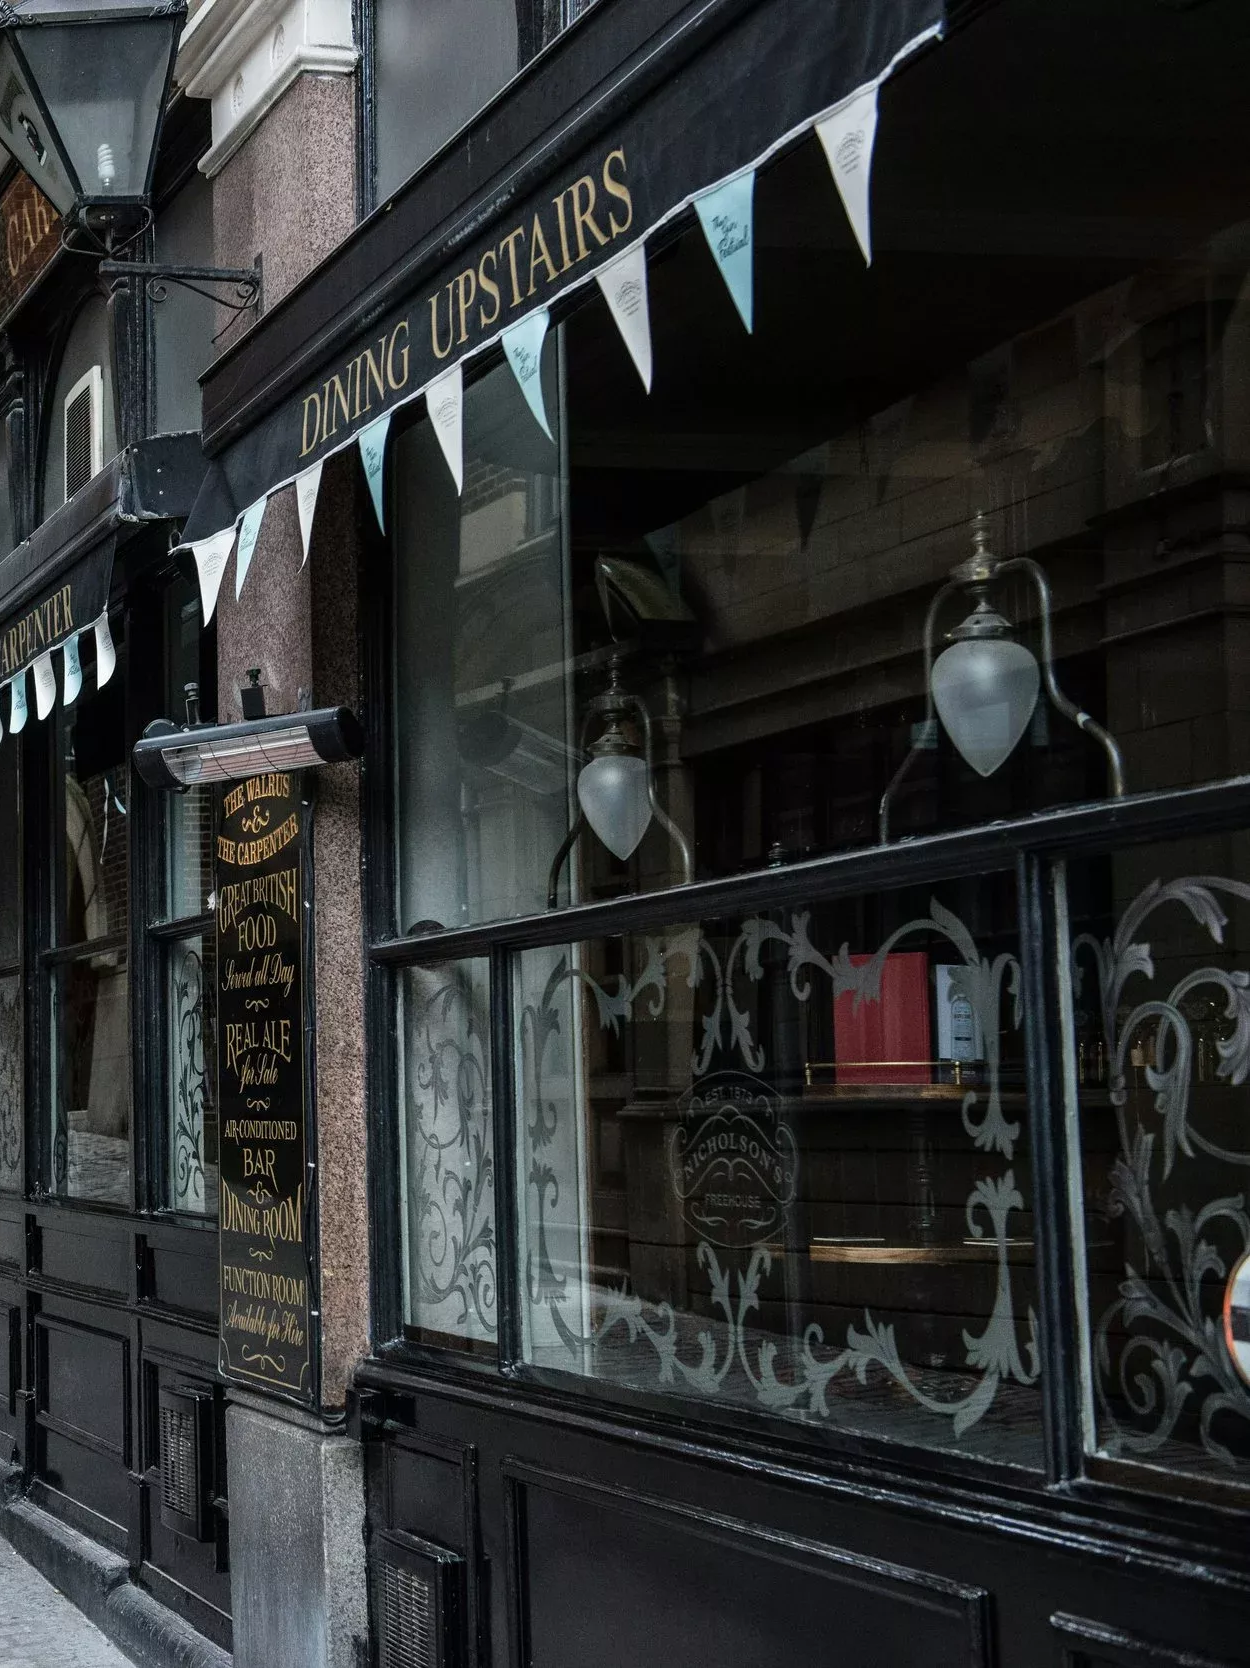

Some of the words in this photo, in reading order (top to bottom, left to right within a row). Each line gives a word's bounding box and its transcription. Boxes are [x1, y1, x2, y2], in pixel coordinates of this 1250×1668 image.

[299, 321, 410, 458] DINING
[428, 146, 633, 359] UPSTAIRS
[223, 784, 246, 818] THE
[246, 773, 290, 802] WALRUS
[217, 835, 236, 864] THE
[237, 812, 299, 866] CARPENTER
[241, 805, 270, 833] &
[218, 879, 252, 934] GREAT
[252, 868, 299, 923] BRITISH
[238, 912, 276, 952] FOOD
[222, 957, 253, 992] Served
[254, 953, 269, 985] all
[268, 951, 295, 997] Day
[226, 1022, 259, 1070] REAL
[263, 1019, 292, 1064] ALE
[239, 1056, 255, 1094] for
[254, 1053, 278, 1086] Sale
[224, 1119, 297, 1146] AIR-CONDITIONED
[243, 1148, 278, 1192] BAR
[683, 1132, 783, 1185] NICHOLSON'S
[221, 1176, 261, 1236] DINING
[262, 1182, 302, 1250] ROOM
[246, 1181, 272, 1205] &
[223, 1264, 271, 1298] FUNCTION
[272, 1278, 303, 1309] ROOM
[224, 1300, 267, 1338] Available
[265, 1309, 281, 1347] for
[280, 1310, 304, 1347] Hire
